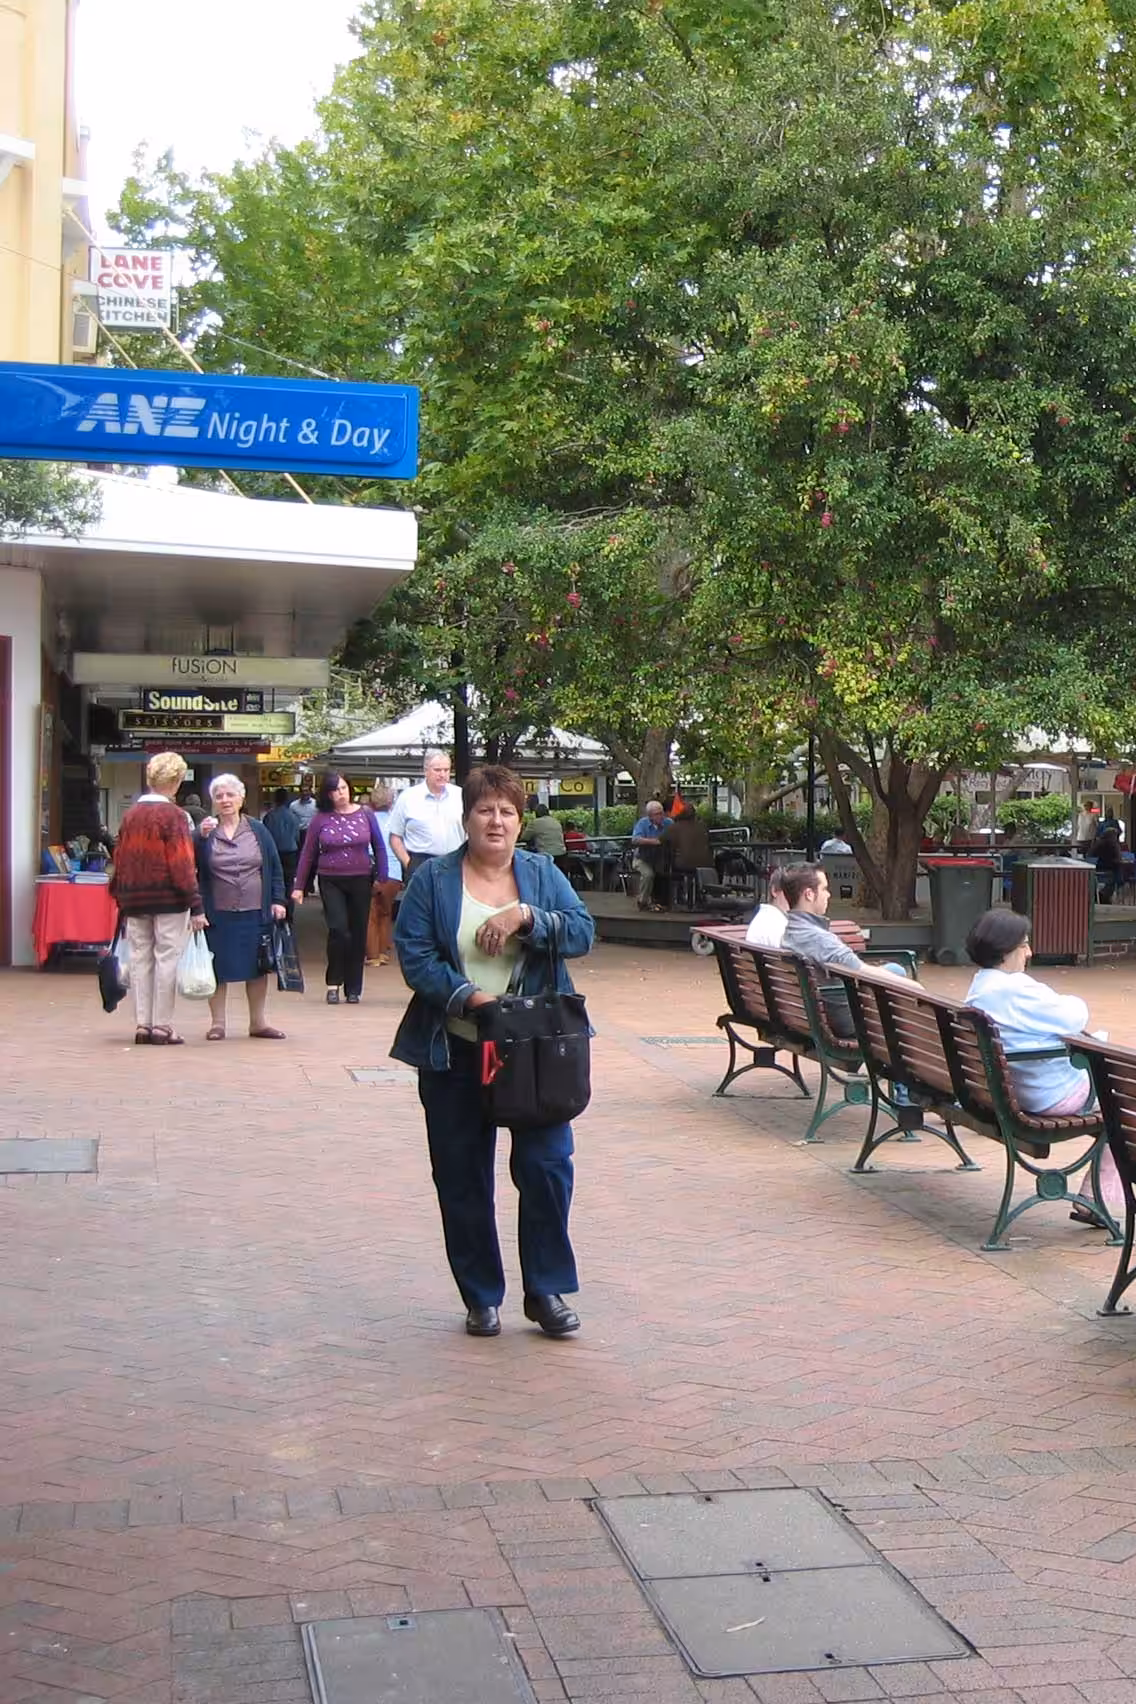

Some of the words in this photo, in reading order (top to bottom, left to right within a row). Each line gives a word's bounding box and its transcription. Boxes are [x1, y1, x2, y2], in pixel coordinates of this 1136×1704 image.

[101, 255, 163, 271] LANE
[98, 273, 164, 290] COVE
[76, 393, 206, 438] ANZ
[207, 411, 290, 449] Night
[297, 418, 319, 445] &
[330, 418, 391, 455] Day
